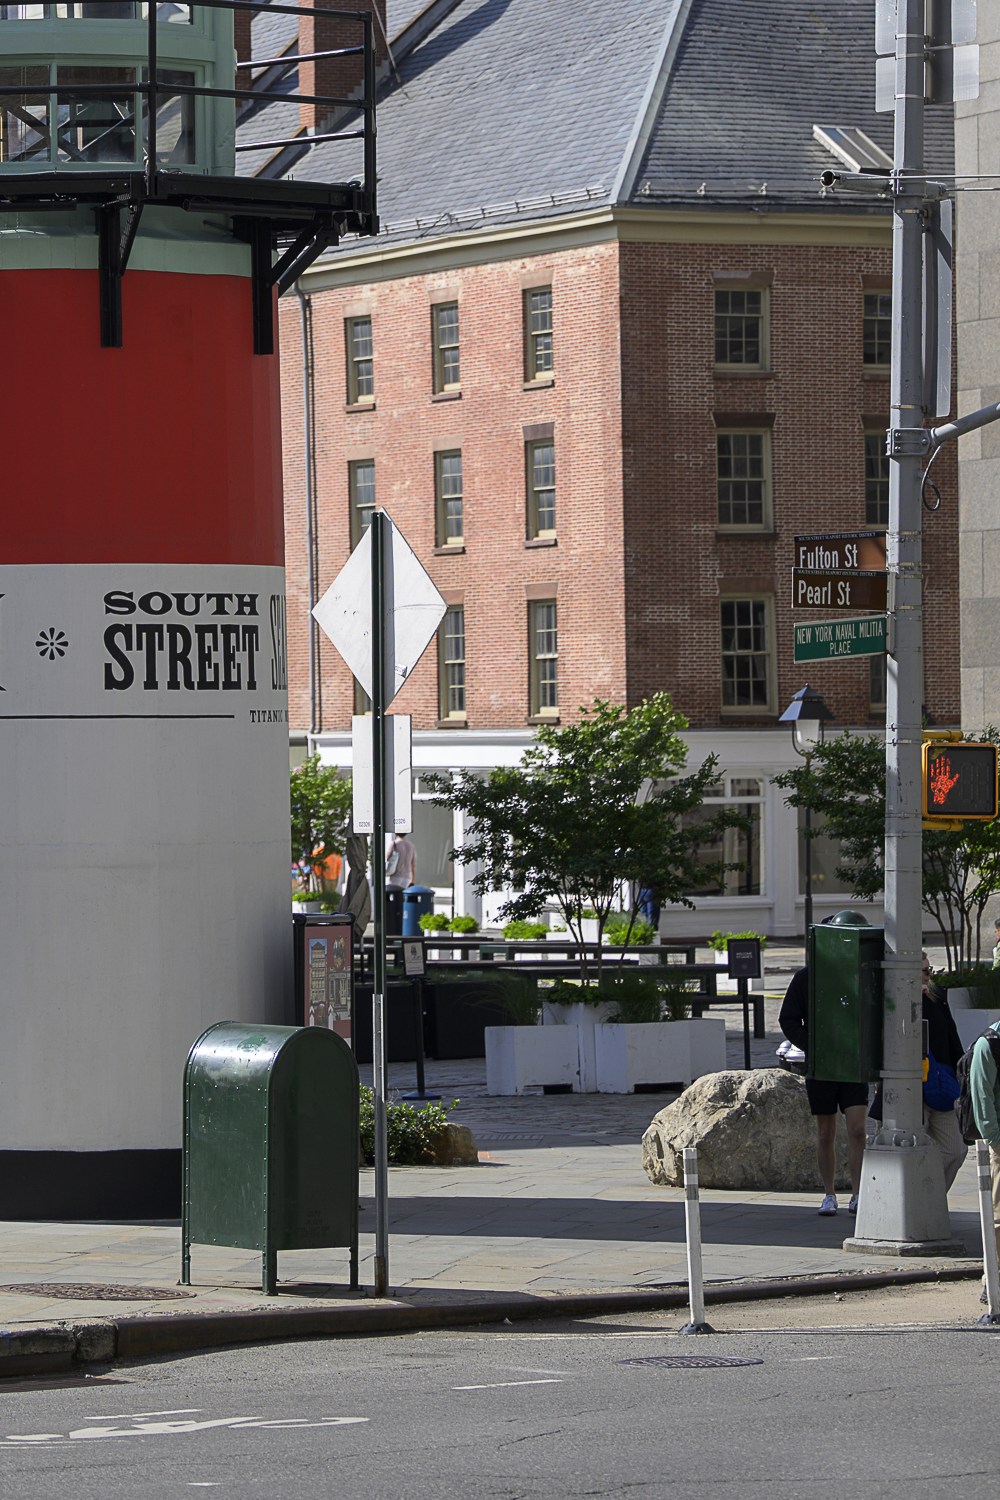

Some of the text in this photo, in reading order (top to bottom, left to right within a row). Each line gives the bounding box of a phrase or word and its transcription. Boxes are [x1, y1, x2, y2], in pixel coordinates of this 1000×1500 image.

[800, 543, 858, 569] Fulton St
[104, 590, 259, 617] SOUTH
[798, 580, 851, 606] Pearl St
[797, 621, 883, 645] NEW YORK NAVAL MILITIA
[103, 623, 259, 691] STREET
[830, 640, 852, 655] PLACE
